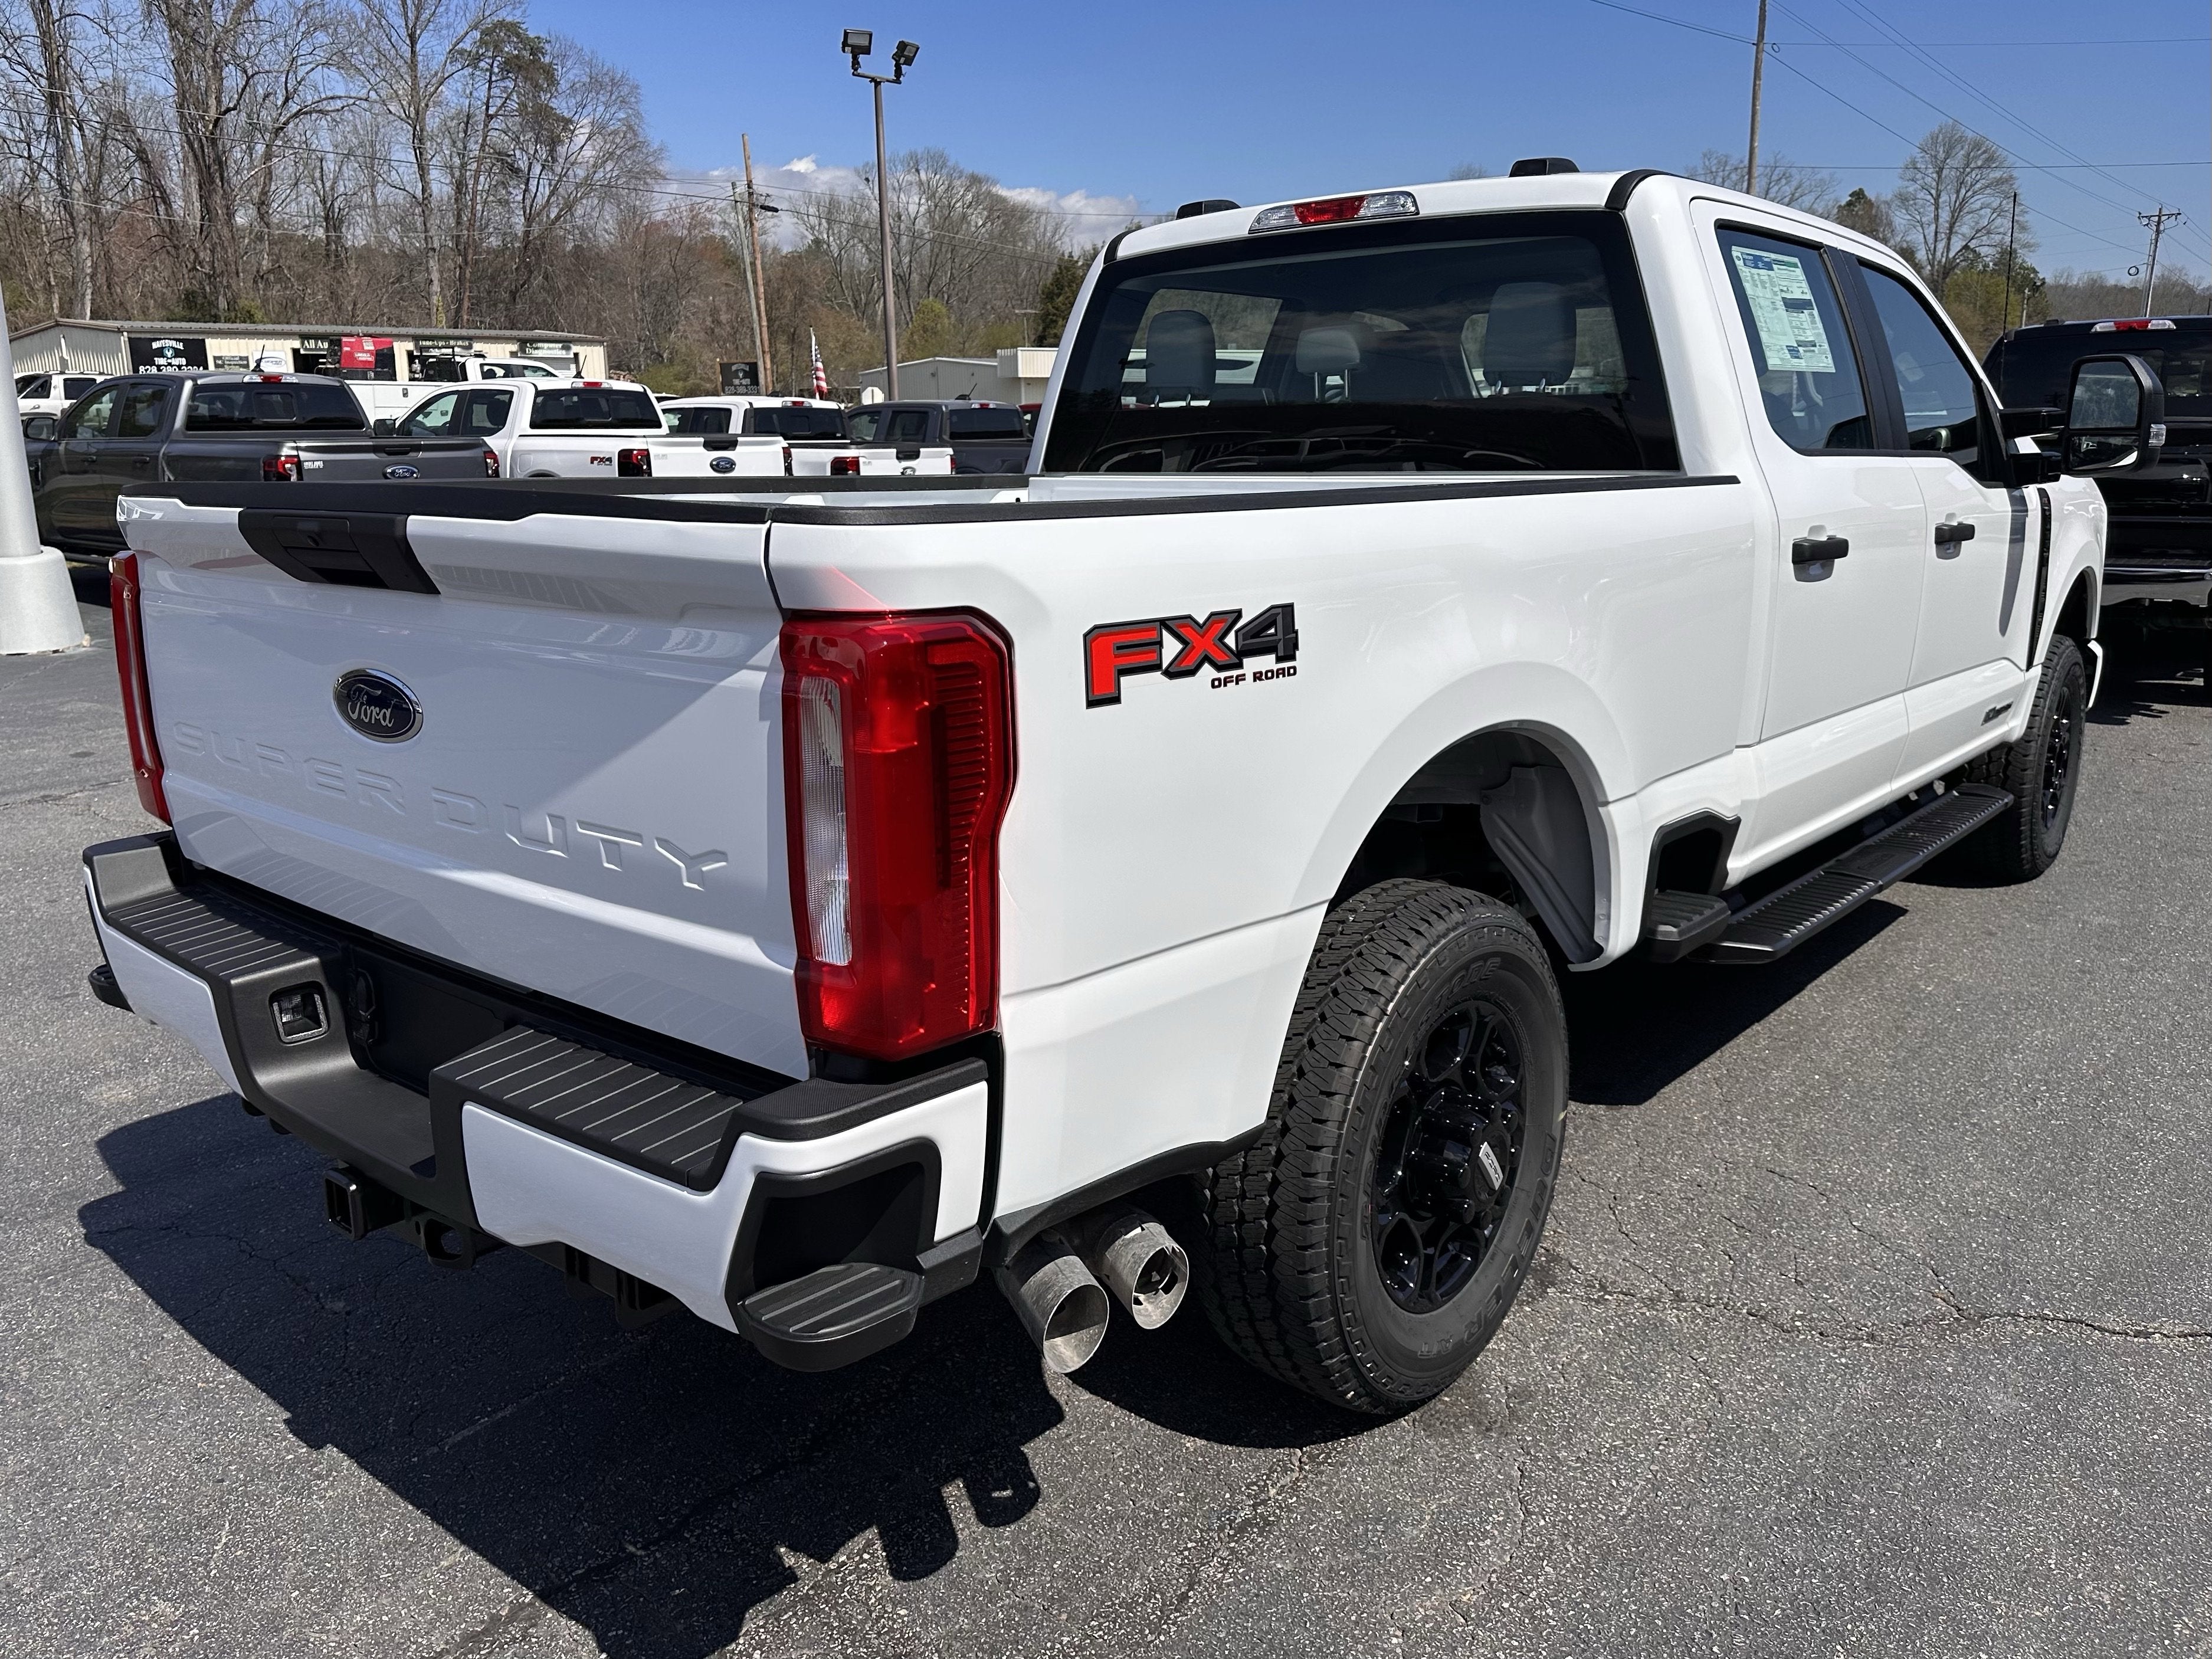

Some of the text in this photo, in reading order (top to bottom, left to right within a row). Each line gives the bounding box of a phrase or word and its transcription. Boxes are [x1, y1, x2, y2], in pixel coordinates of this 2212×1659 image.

[152, 339, 184, 349] HAYESVILLE
[303, 339, 315, 349] All
[590, 456, 612, 464] FX4
[1083, 602, 1299, 709] FX4
[1211, 665, 1297, 689] OFF ROAD
[348, 684, 394, 727] Ford
[173, 722, 729, 891] SUPER DUTY
